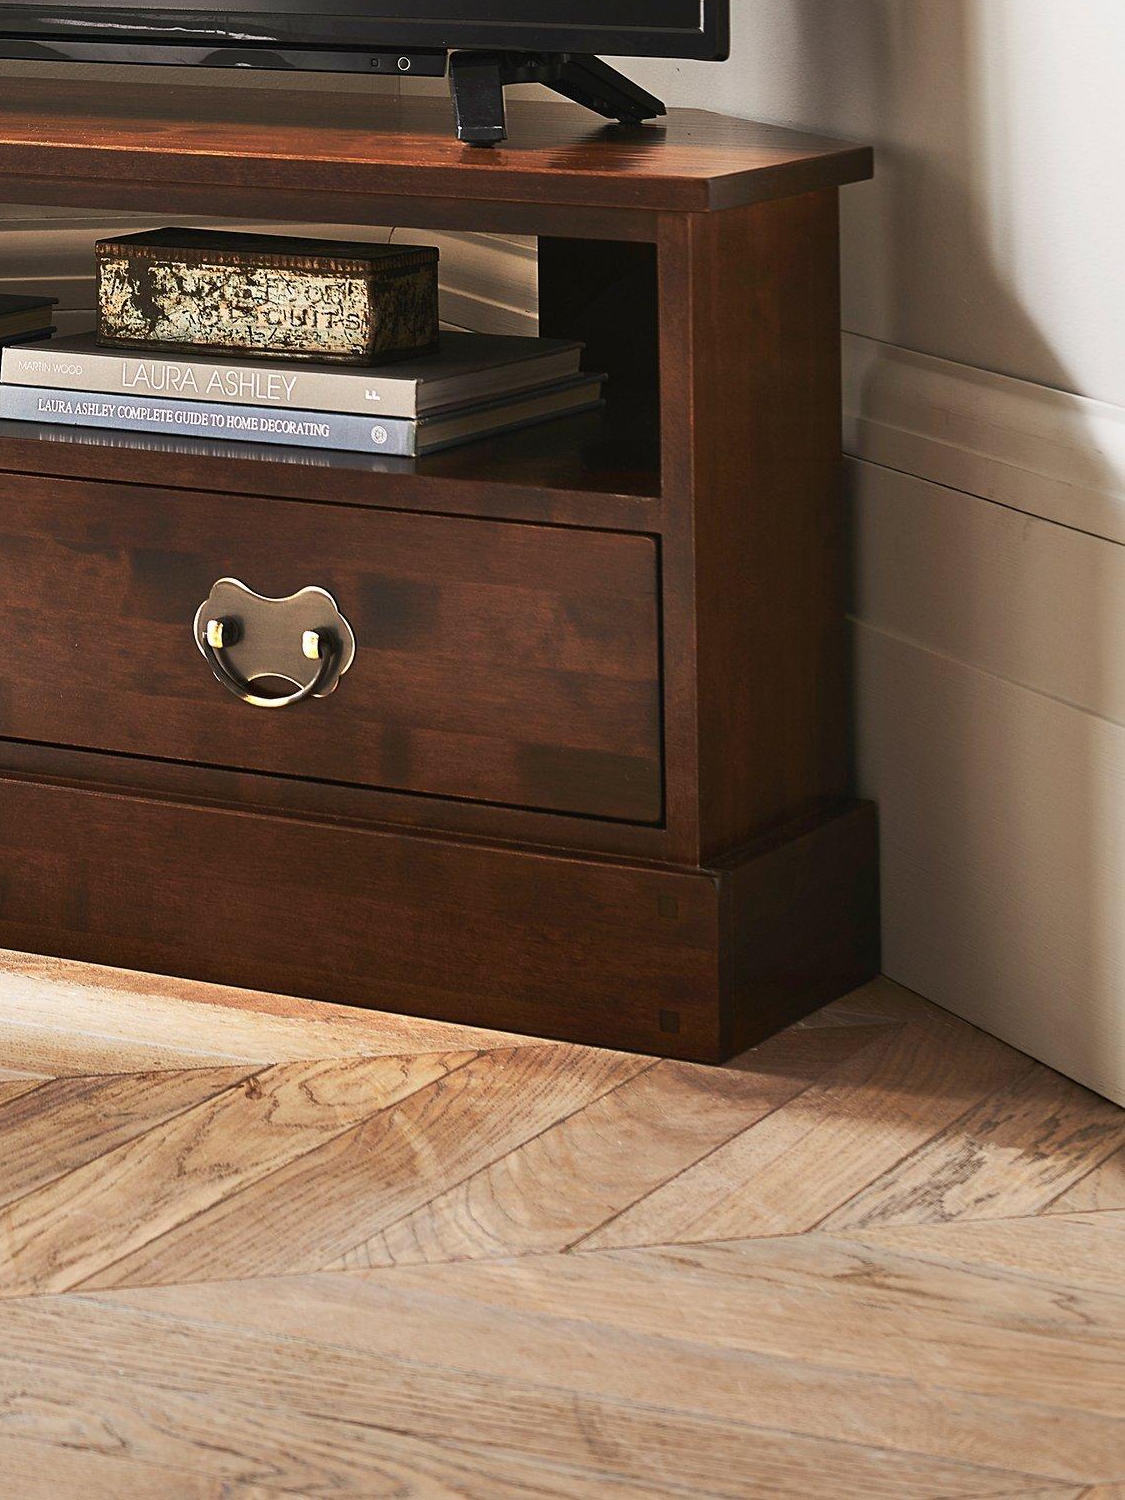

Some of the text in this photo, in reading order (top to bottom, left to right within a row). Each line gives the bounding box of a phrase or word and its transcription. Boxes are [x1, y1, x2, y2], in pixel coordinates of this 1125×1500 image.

[18, 360, 297, 401] MARTIN WOOD LAURA ASHLEY
[38, 399, 331, 438] LAURA ASHLEY COMPLETE GUIDE TO HOME DECORATING
